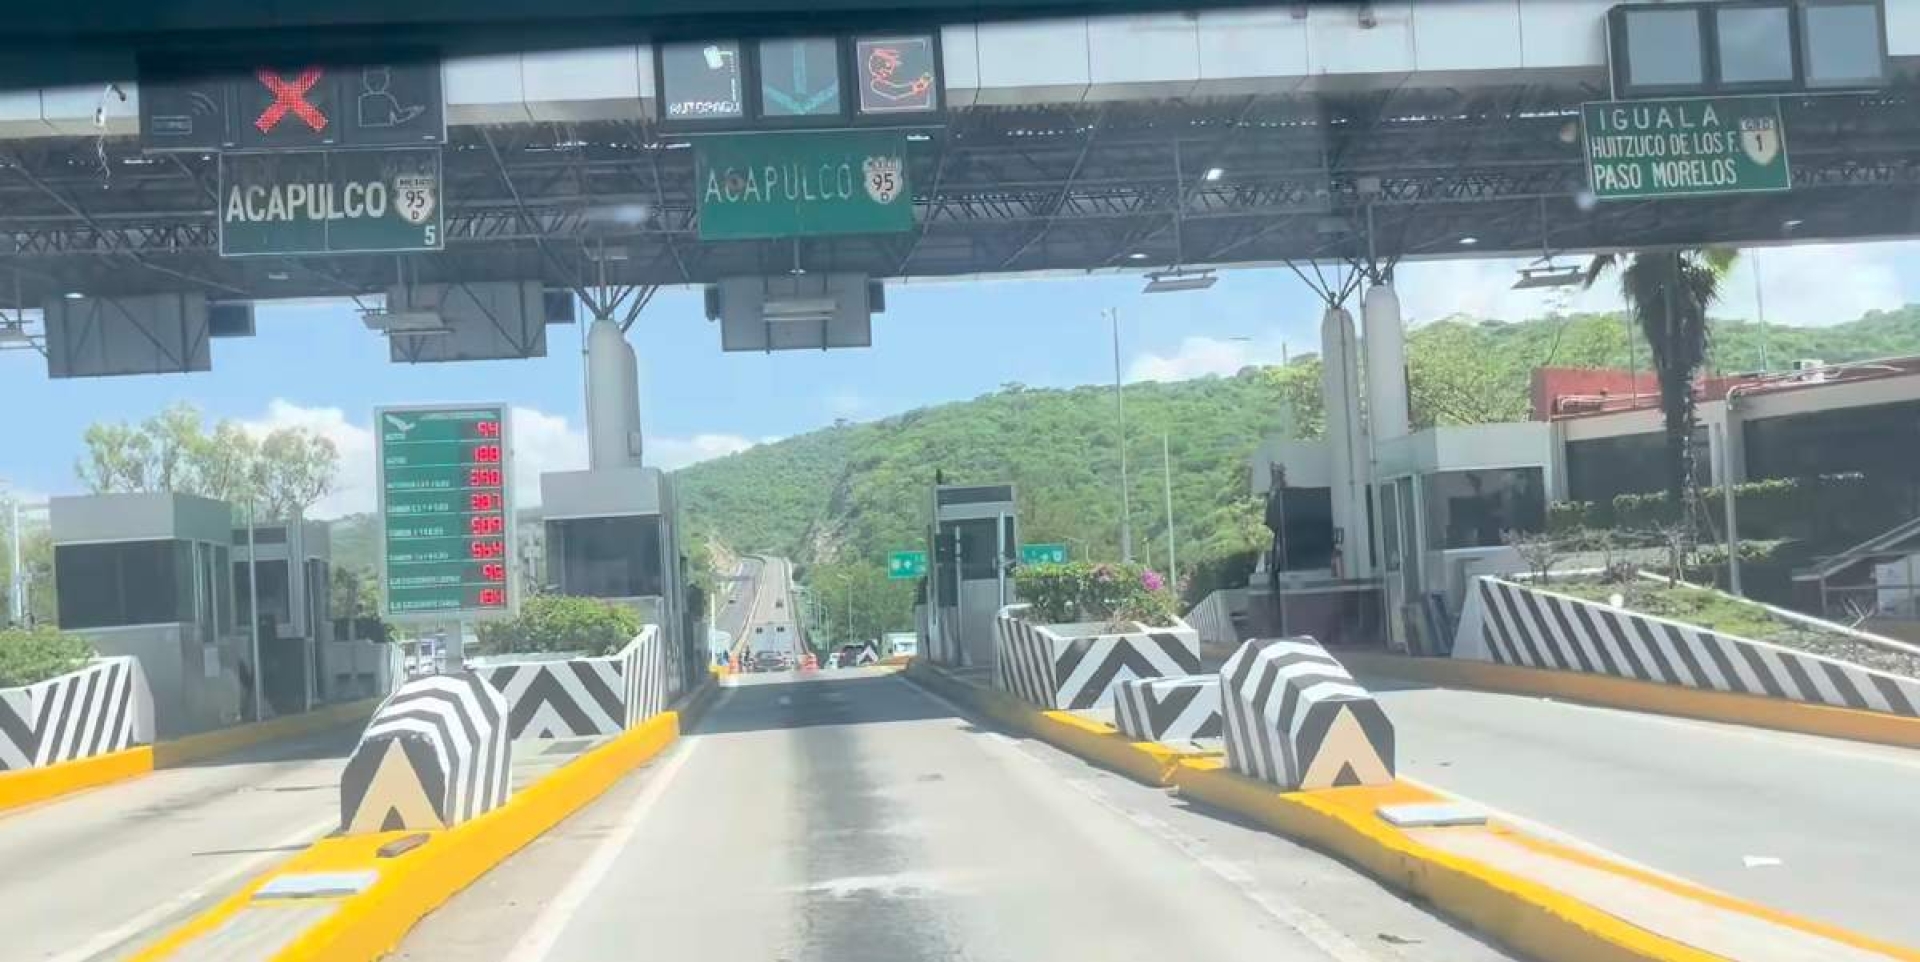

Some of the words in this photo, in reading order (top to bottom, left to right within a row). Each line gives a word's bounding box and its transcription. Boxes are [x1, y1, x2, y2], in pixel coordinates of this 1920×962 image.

[1599, 104, 1719, 131] IGUALA
[1591, 135, 1665, 159] HUITZUCO
[1670, 134, 1690, 156] DE
[1694, 132, 1724, 155] LOS
[1755, 134, 1763, 152] 1
[704, 163, 853, 204] ACAPULCO
[872, 173, 894, 191] 95
[1594, 163, 1642, 190] PASO
[1651, 159, 1737, 188] MORELOS
[226, 182, 386, 222] ACAPULCO
[406, 190, 425, 209] 95
[881, 192, 889, 201] D
[412, 210, 420, 220] D
[424, 225, 436, 246] 5
